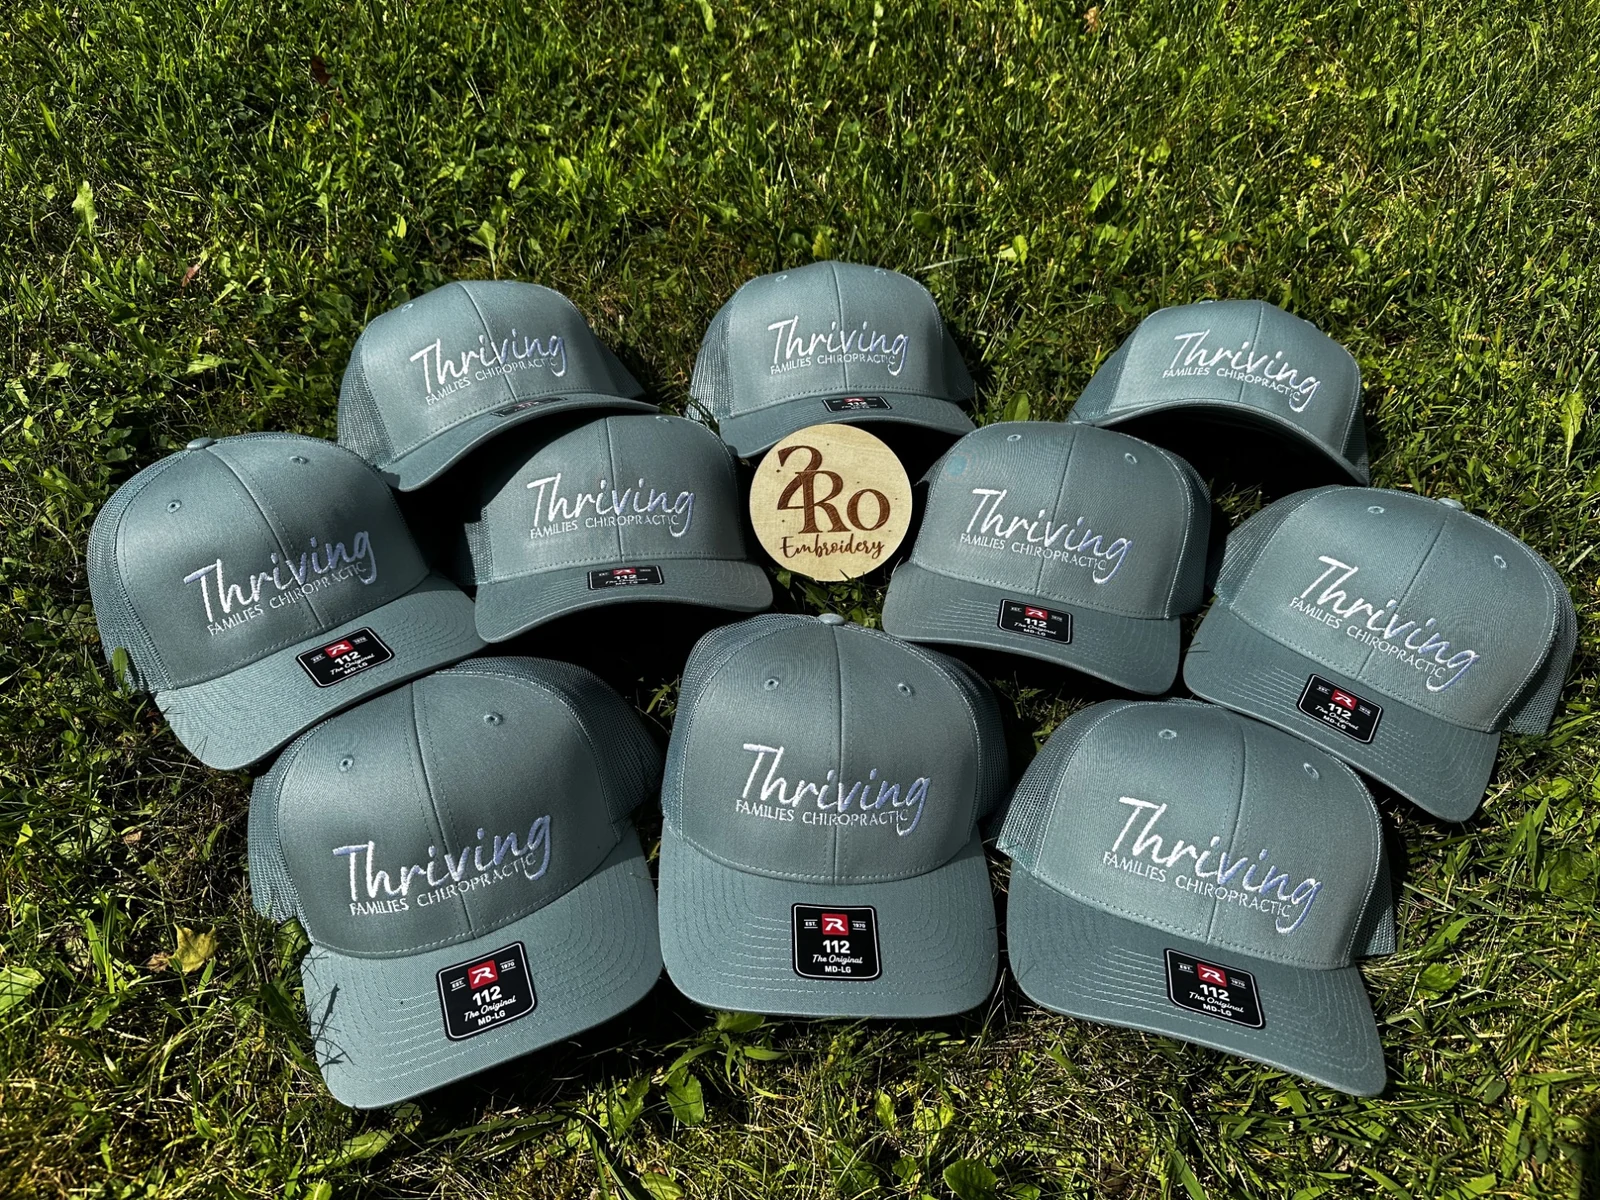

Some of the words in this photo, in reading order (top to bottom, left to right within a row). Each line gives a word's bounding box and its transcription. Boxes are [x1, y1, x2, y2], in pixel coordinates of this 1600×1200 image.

[766, 315, 908, 376] Thriving
[409, 328, 567, 394] Thriving
[770, 357, 812, 375] FAMILIES
[817, 352, 895, 365] CHIROPRACTIC
[1170, 329, 1320, 412] Thriving
[425, 377, 471, 406] FAMILIES
[474, 357, 557, 381] CHIROPRACTIC
[1162, 367, 1210, 379] FAMILIES
[1216, 367, 1301, 401] CHIROPRACTIC
[526, 473, 694, 537] Thriving
[530, 520, 578, 539] FAMILIES
[585, 514, 680, 528] CHIROPRACTIC
[966, 488, 1133, 584] Thriving
[779, 533, 885, 559] Embroidery
[960, 533, 1006, 550] FAMILIES
[1011, 542, 1106, 571] CHIROPRACTIC
[183, 531, 377, 622] Thriving
[207, 603, 264, 636] FAMILIES
[269, 561, 366, 609] CHIROPRACTIC
[1024, 617, 1047, 628] 112
[1027, 625, 1056, 635] Original
[1300, 555, 1480, 692] Thriving
[1289, 597, 1342, 629] FAMILIES
[1346, 625, 1446, 679] CHIROPRACTIC
[330, 666, 344, 675] The
[344, 653, 375, 669] Original
[334, 651, 361, 665] 112
[1315, 705, 1328, 715] The
[1329, 712, 1359, 731] Original
[1328, 703, 1352, 720] 112
[742, 743, 930, 836] Thriving
[735, 799, 795, 822] FAMILIES
[802, 810, 908, 827] CHIROPRACTIC
[332, 815, 550, 881] Thriving
[1111, 796, 1322, 934] Thriving
[349, 898, 409, 916] FAMILIES
[416, 852, 536, 907] CHIROPRACTIC
[1102, 851, 1166, 883] FAMILIES
[1175, 874, 1292, 918] CHIROPRACTIC
[812, 954, 828, 963] The
[828, 954, 863, 965] Original
[822, 940, 851, 954] 112
[501, 961, 515, 970] 1970
[824, 965, 852, 973] MD-LG
[472, 985, 502, 1006] 112
[1189, 991, 1205, 1001] The
[1206, 997, 1245, 1013] Original
[1200, 984, 1230, 1001] 112
[464, 1011, 480, 1022] The
[480, 995, 517, 1015] Original
[477, 1010, 506, 1026] MD-LG
[1202, 1003, 1232, 1017] MD-LG
